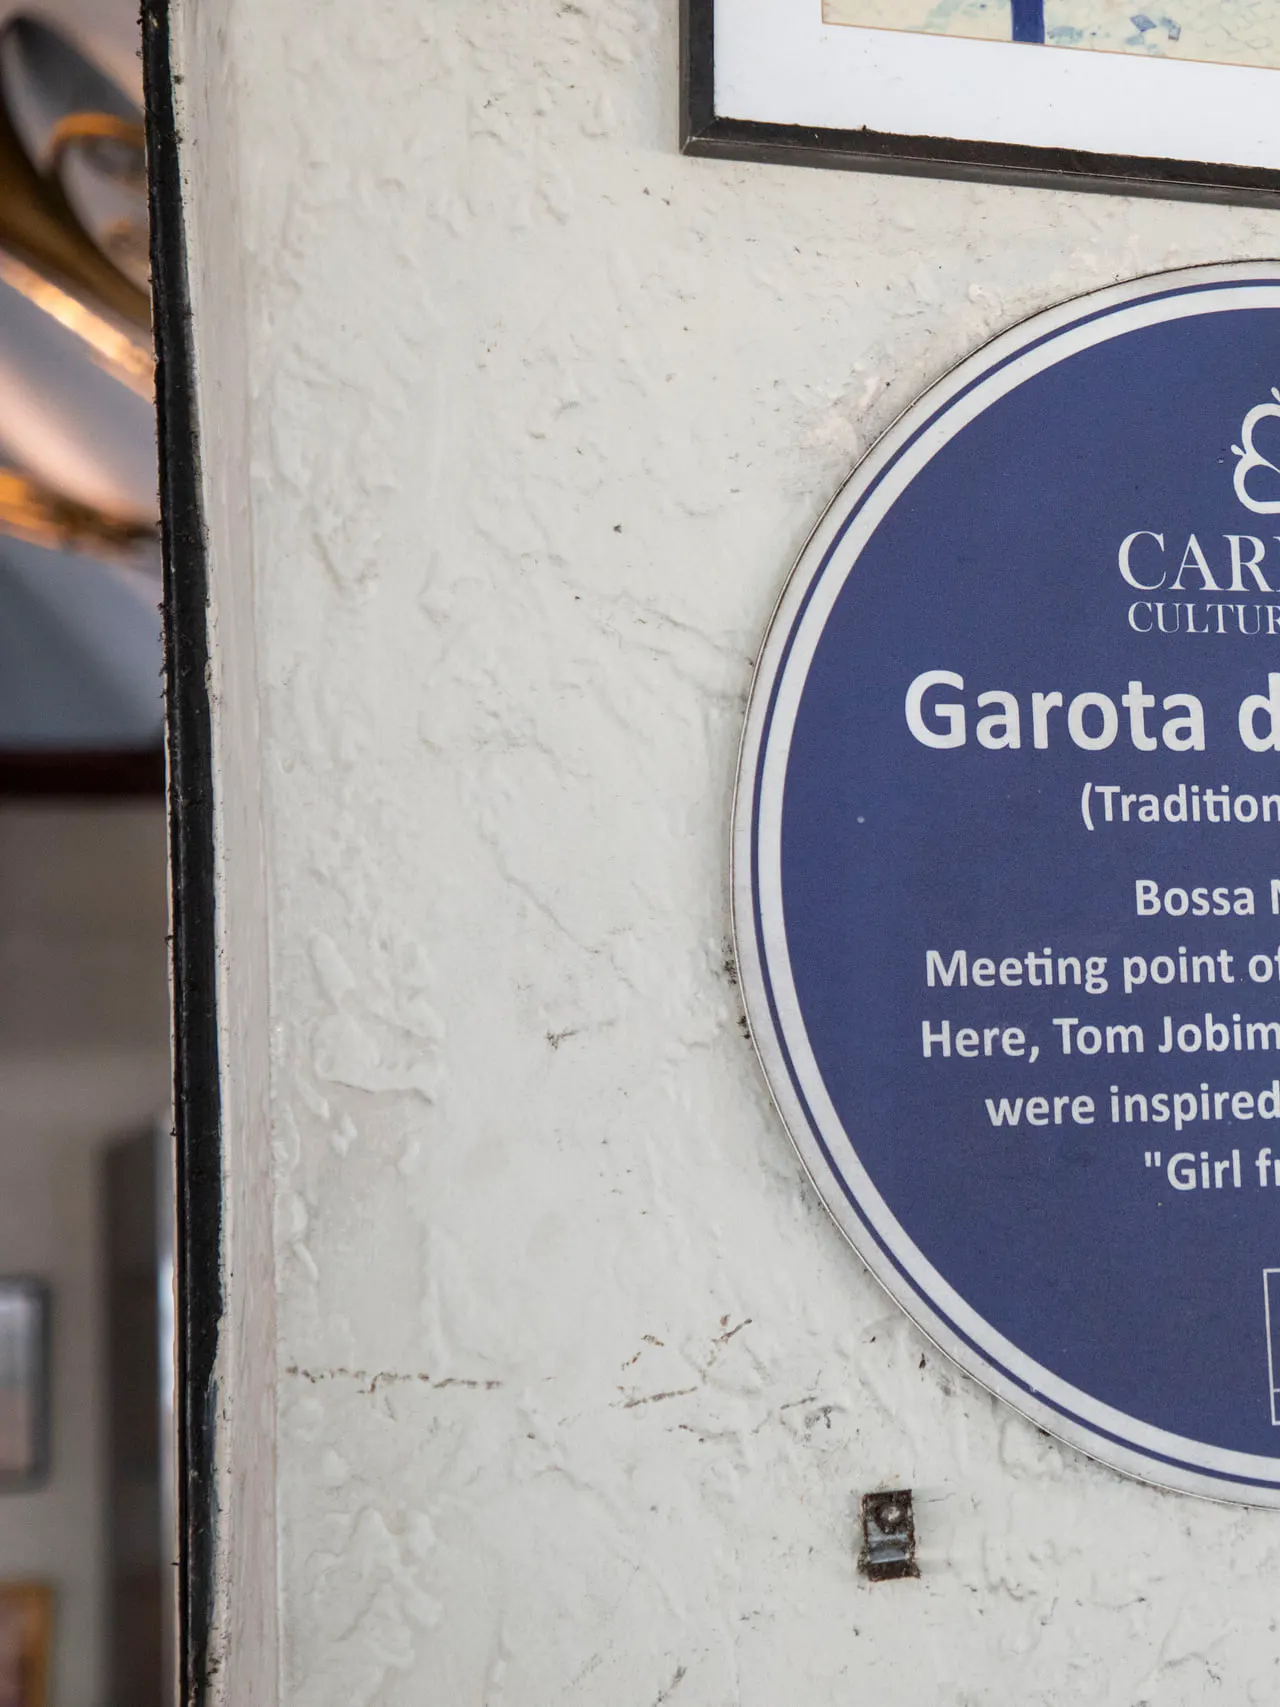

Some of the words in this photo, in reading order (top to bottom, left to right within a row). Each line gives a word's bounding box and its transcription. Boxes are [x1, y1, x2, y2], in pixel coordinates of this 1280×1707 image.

[904, 669, 1206, 752] Garota
[1135, 879, 1255, 917] Bossa
[926, 947, 1109, 995] Meeting
[1123, 946, 1235, 994] point
[921, 1020, 1040, 1064] Here,
[1052, 1017, 1145, 1055] Tom
[984, 1095, 1095, 1127] were
[1144, 1149, 1242, 1191] "Girl
